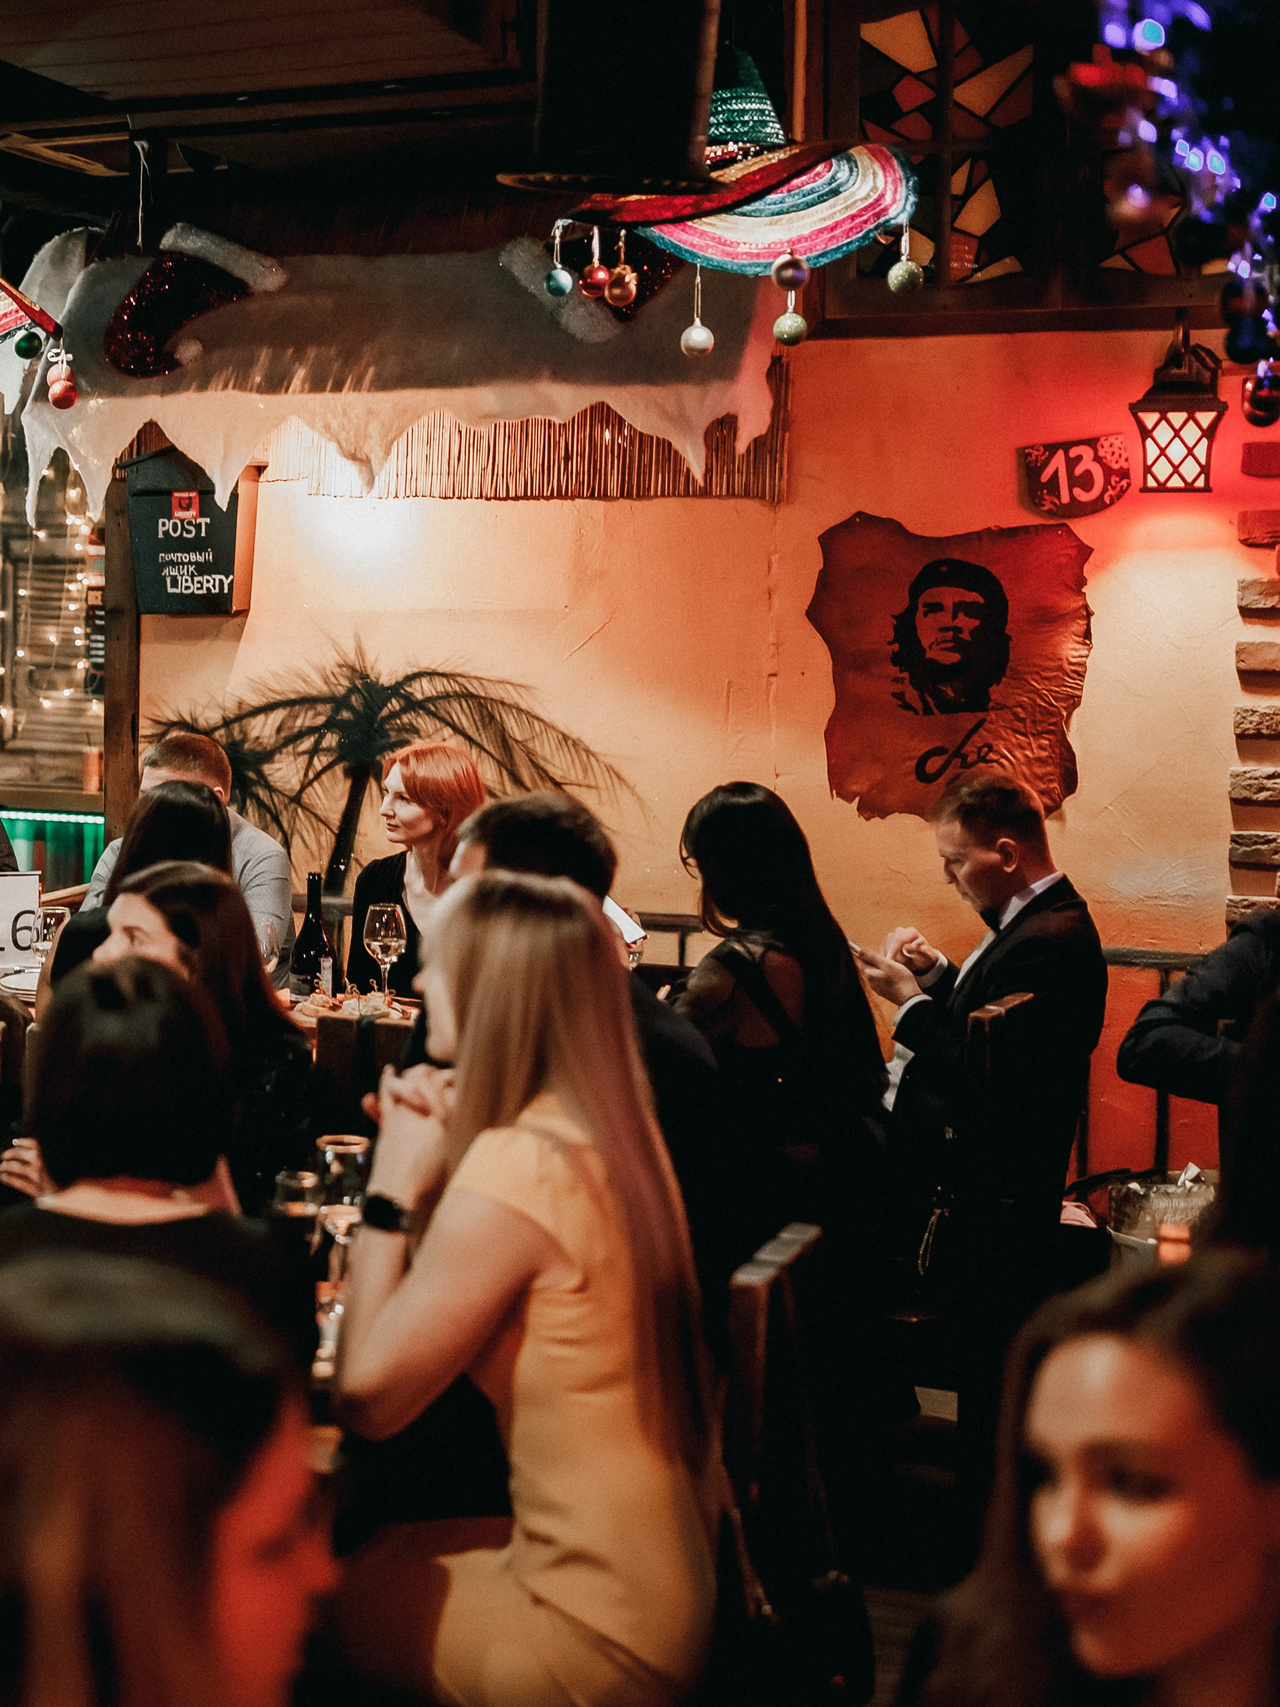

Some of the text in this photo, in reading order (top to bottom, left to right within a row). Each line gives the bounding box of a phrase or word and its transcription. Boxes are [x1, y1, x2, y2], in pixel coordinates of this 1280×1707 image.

[1041, 445, 1104, 504] 13
[158, 517, 210, 538] POST
[166, 574, 233, 594] LIBERTY
